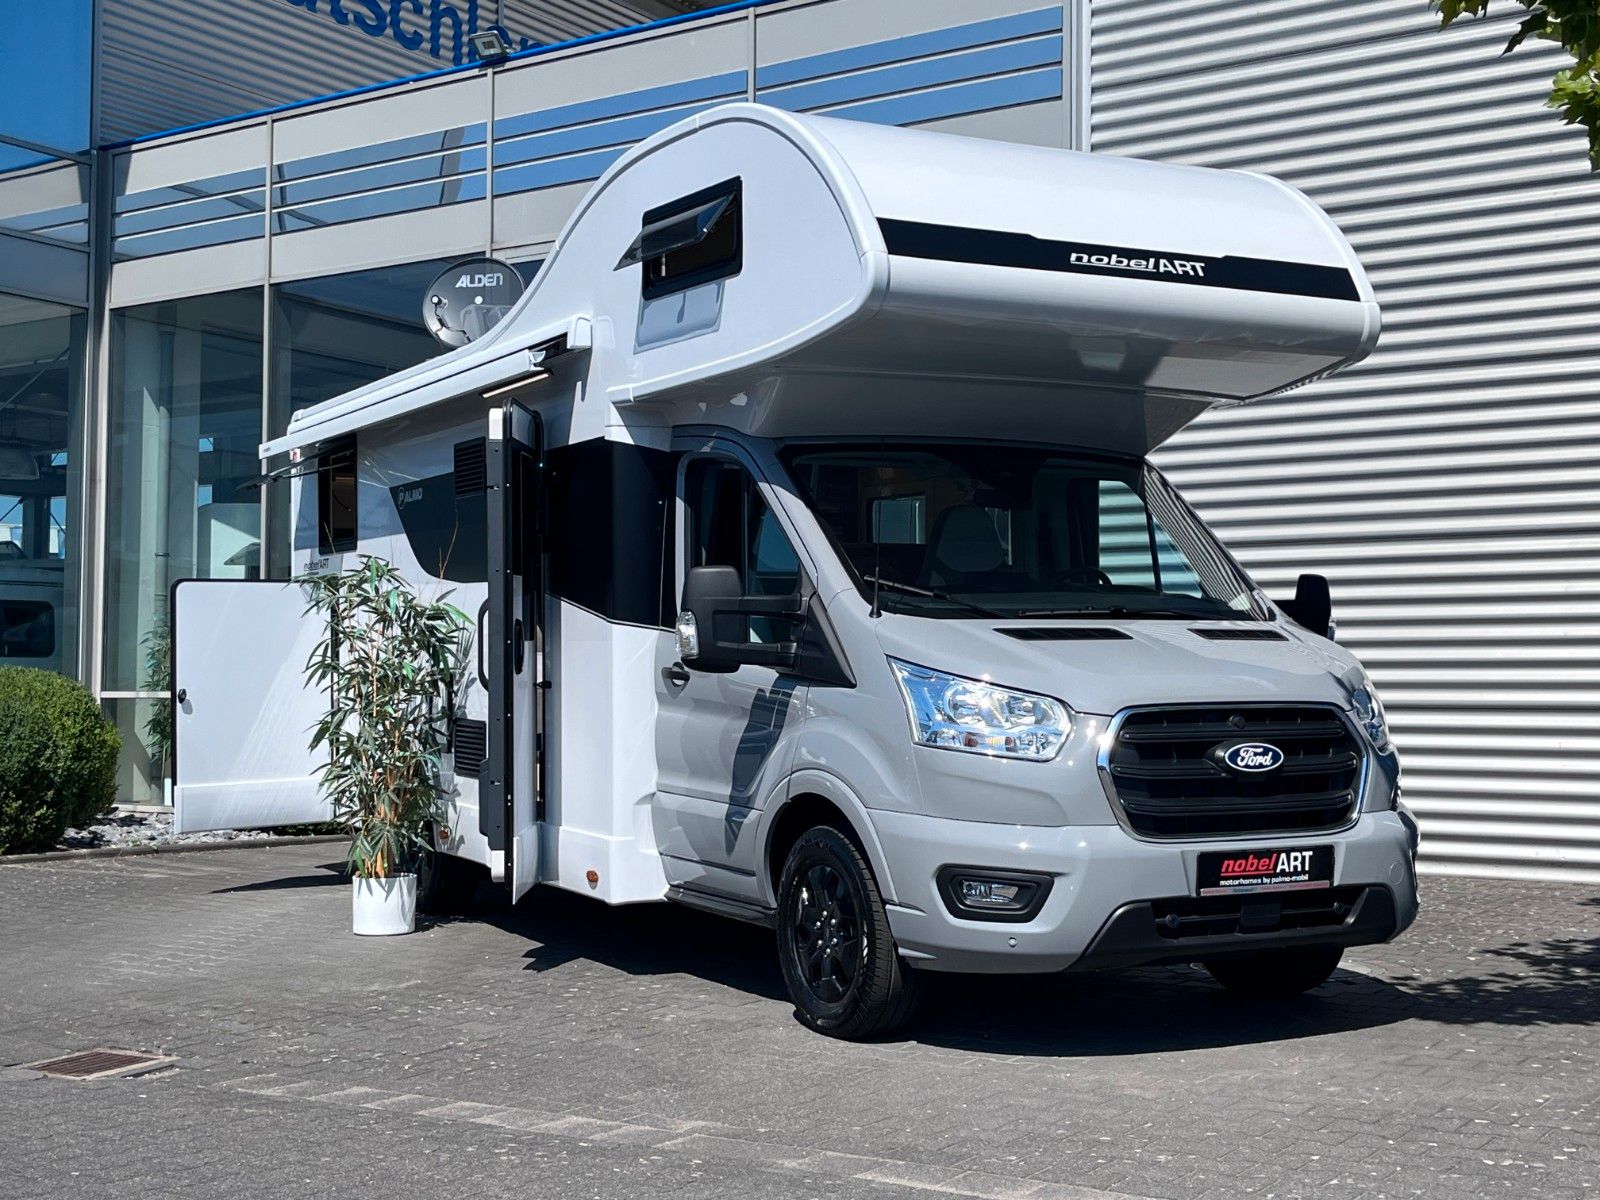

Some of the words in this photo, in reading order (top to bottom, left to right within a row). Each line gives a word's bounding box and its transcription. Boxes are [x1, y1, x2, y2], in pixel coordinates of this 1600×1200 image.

[1069, 252, 1206, 277] nobelART
[454, 272, 504, 289] ALDEN
[1236, 747, 1273, 767] Ford
[1220, 850, 1314, 876] nobelART
[1219, 878, 1262, 886] motorhomes
[1262, 876, 1271, 885] by
